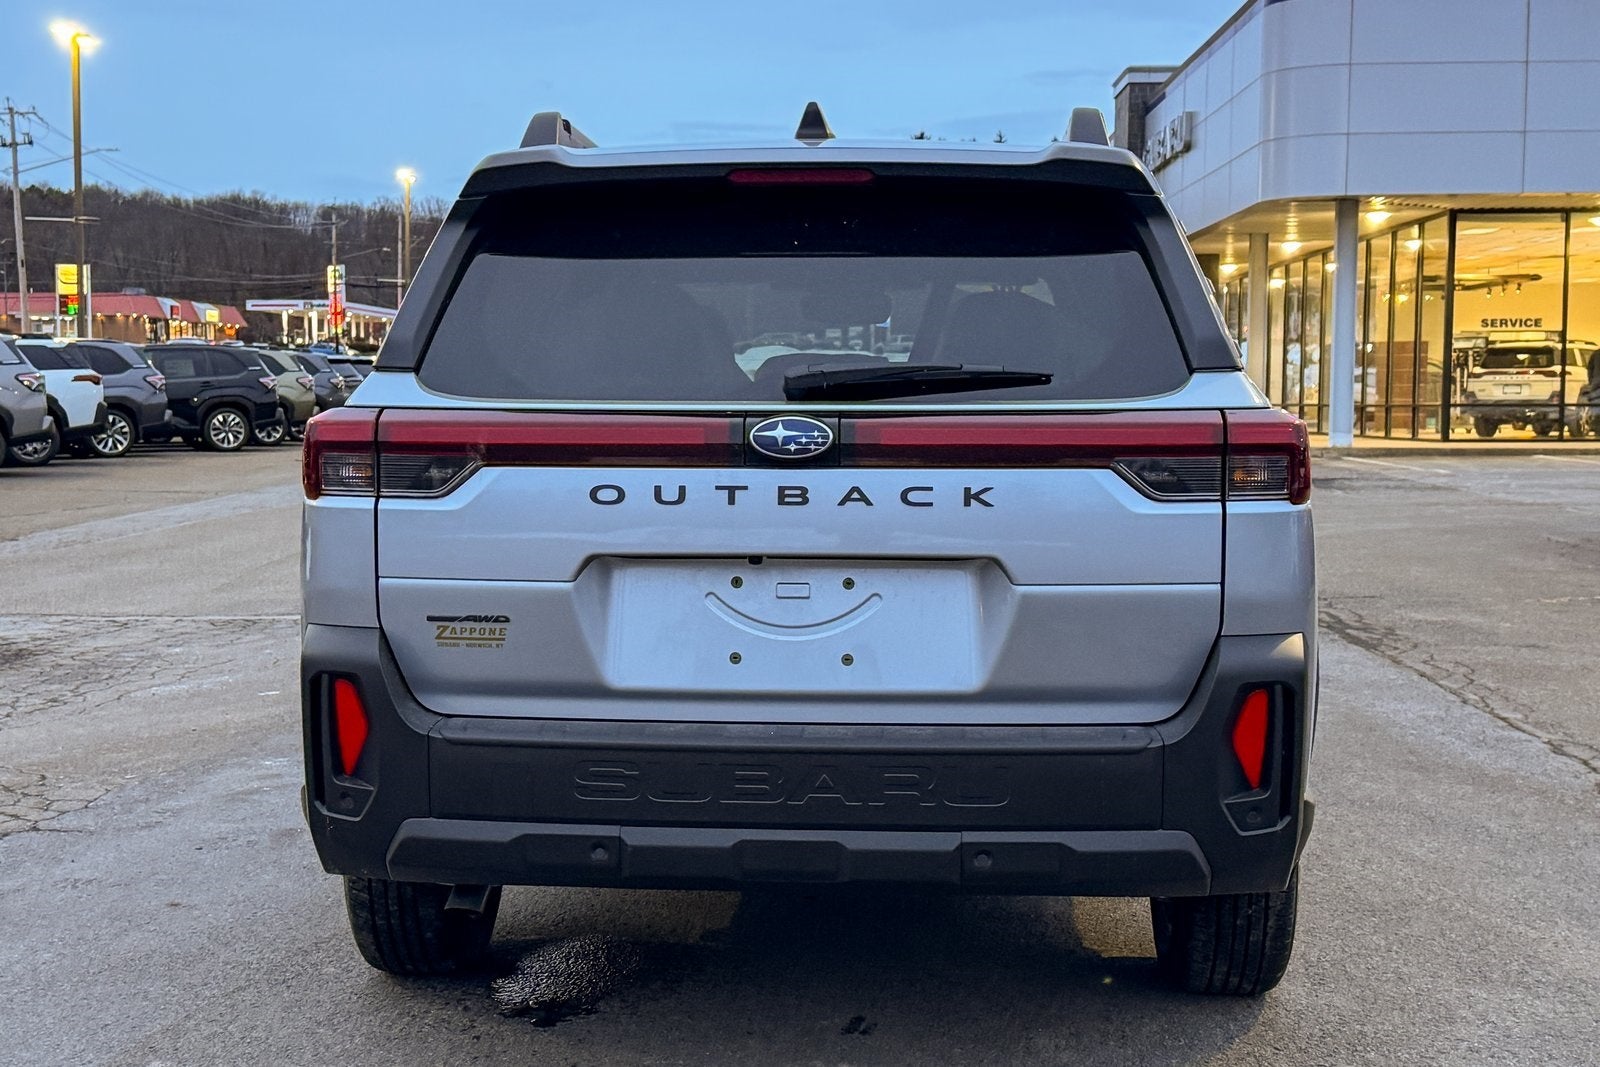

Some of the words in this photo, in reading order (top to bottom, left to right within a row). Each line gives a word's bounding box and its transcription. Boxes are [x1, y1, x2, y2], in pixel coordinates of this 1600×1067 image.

[1481, 318, 1543, 328] SERVICE
[589, 484, 995, 507] OUTBACK
[457, 614, 511, 623] AWD
[435, 625, 507, 640] ZAPPONE
[574, 760, 1010, 807] SUBARU
